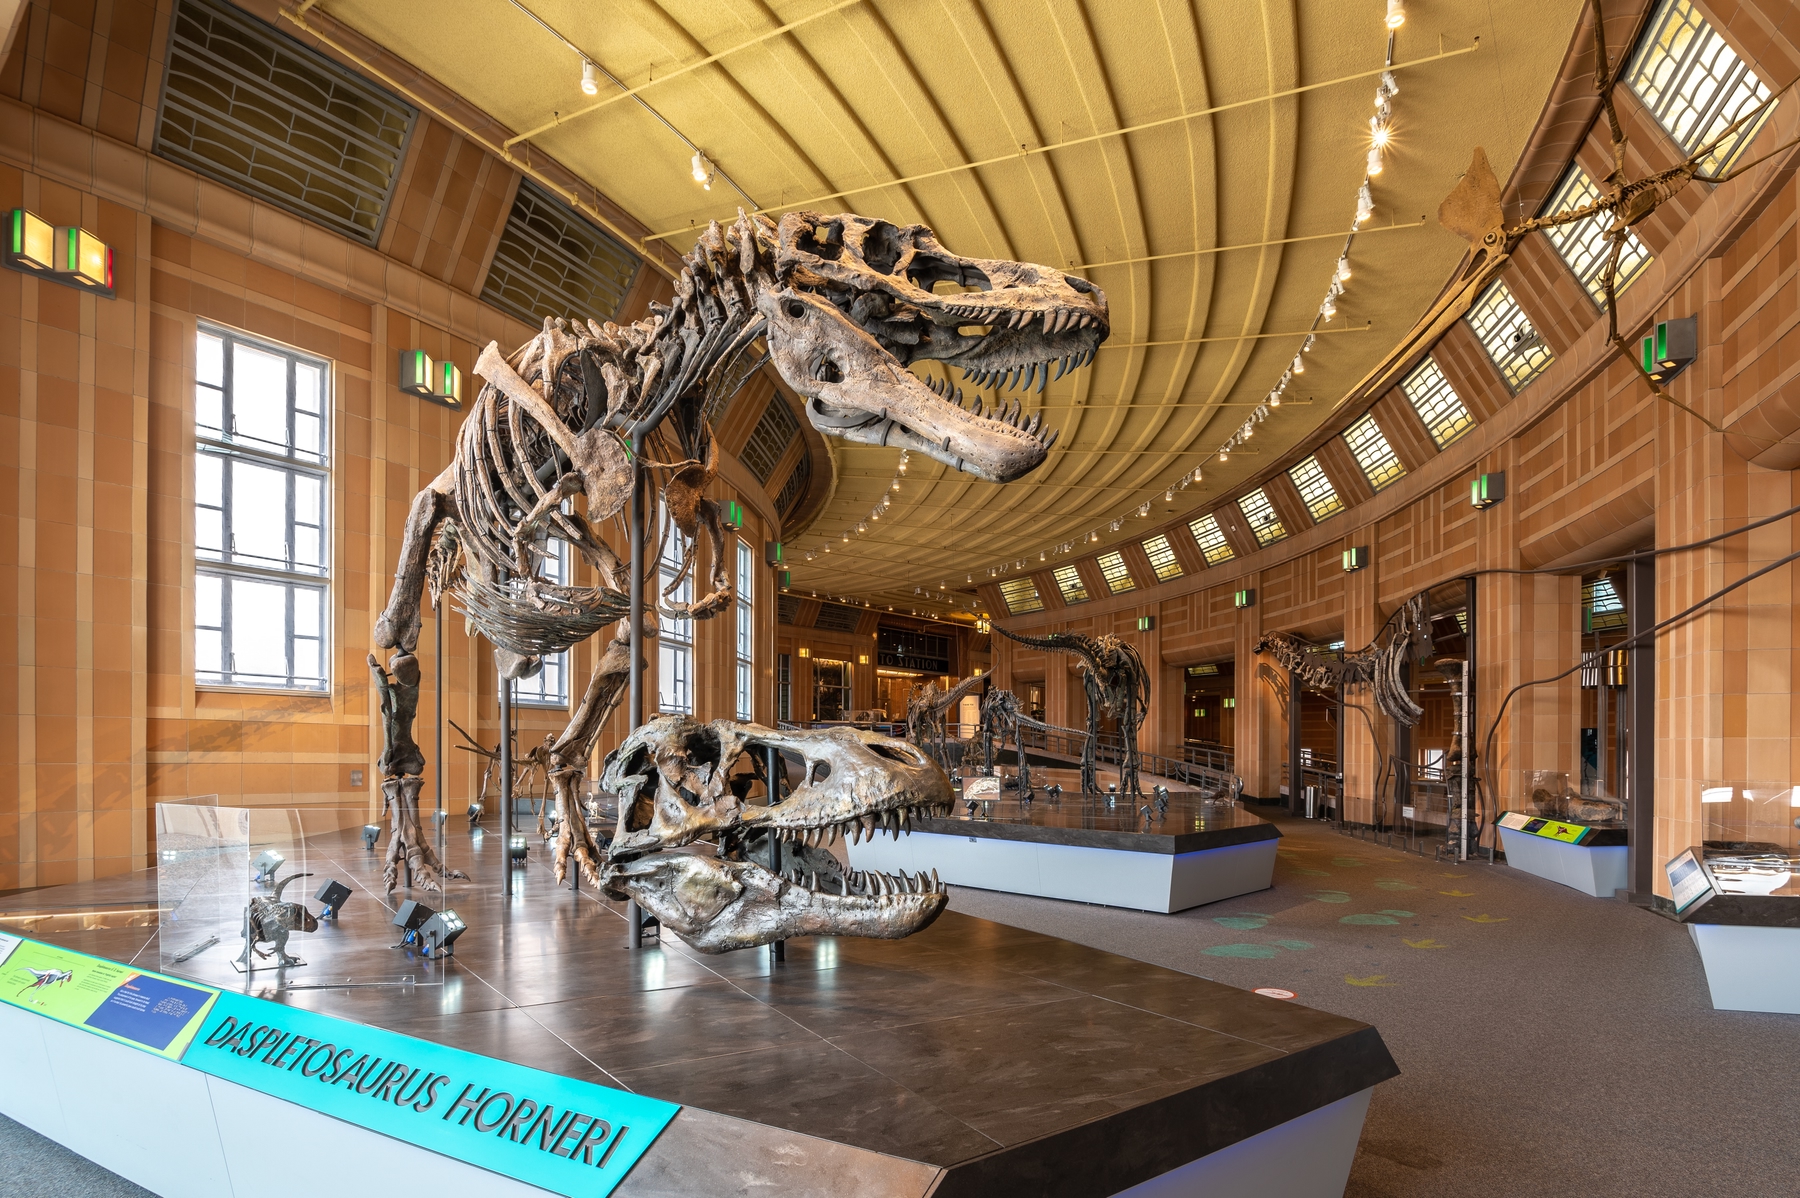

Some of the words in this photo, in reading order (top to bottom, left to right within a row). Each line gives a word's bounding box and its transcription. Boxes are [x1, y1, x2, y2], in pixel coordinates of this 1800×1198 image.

[880, 653, 893, 665] TO
[898, 656, 938, 671] STATION
[203, 1015, 450, 1113] DASPLETOSAURUS
[442, 1083, 630, 1169] HORNERI
